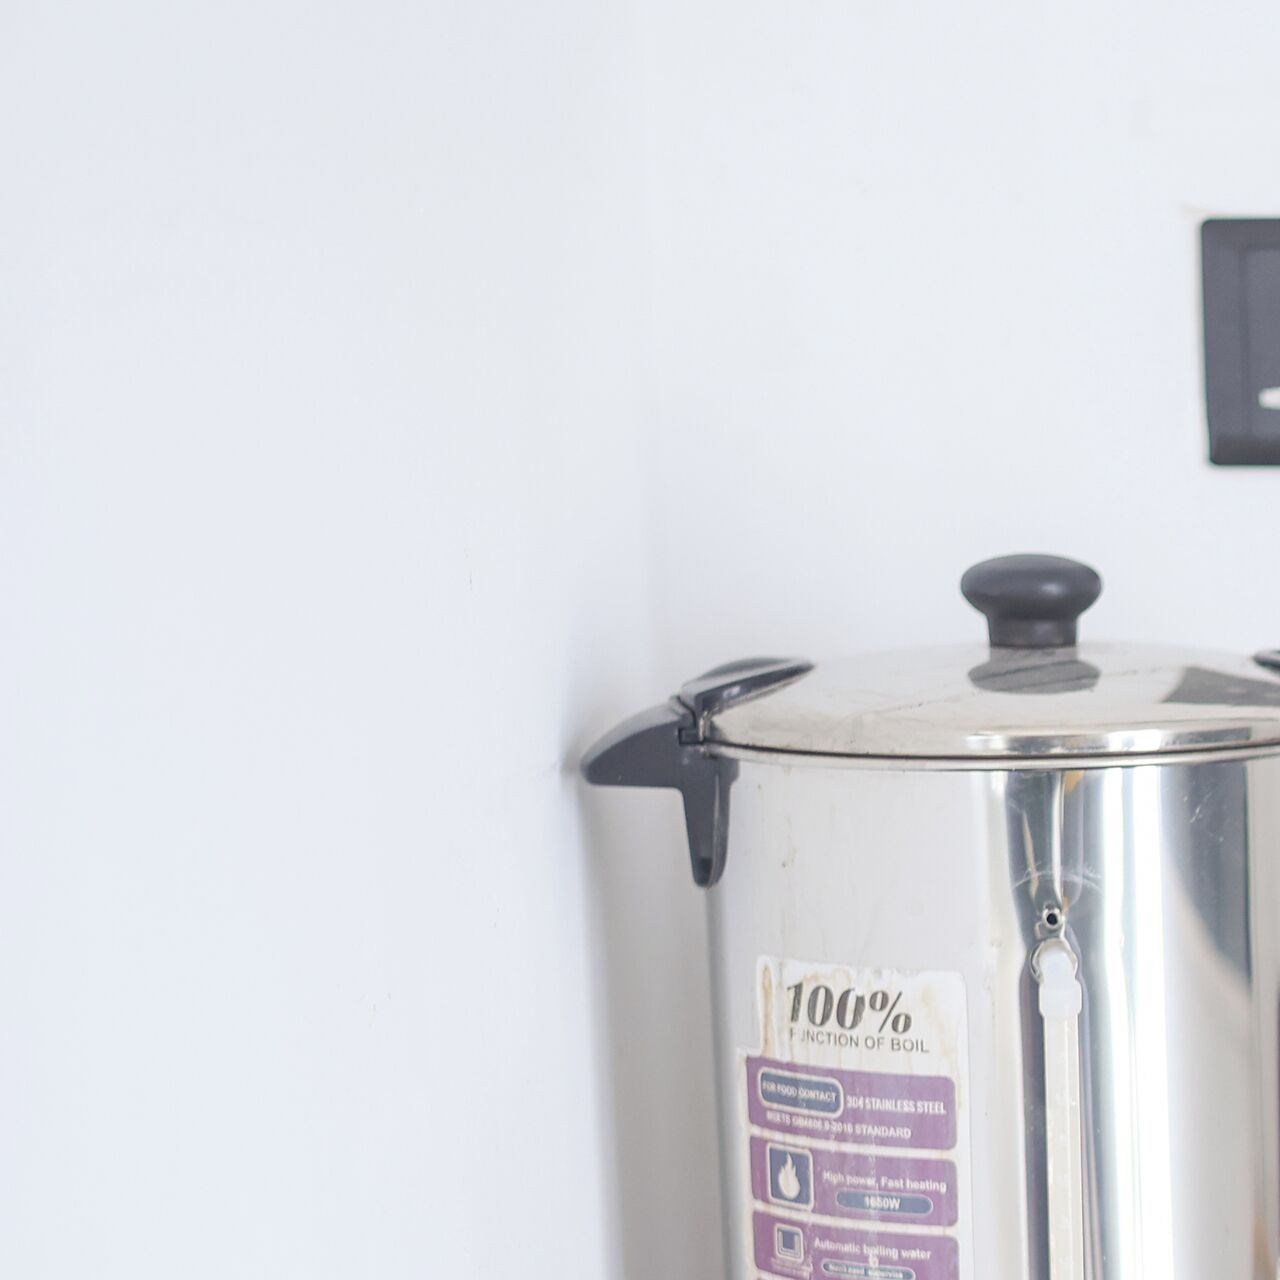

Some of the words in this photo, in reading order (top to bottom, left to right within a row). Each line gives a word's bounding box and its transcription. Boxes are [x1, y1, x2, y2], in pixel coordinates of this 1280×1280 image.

[787, 981, 912, 1035] 100%
[864, 1035, 885, 1050] OF
[890, 1037, 930, 1053] BOIL
[798, 1087, 837, 1102] CONTACT
[865, 1097, 915, 1113] STAINLESS
[917, 1100, 946, 1115] STEEL
[855, 1123, 912, 1138] STANDARD
[823, 1171, 844, 1185] High
[881, 1176, 904, 1188] Fast
[906, 1178, 947, 1194] heating
[814, 1238, 861, 1253] Automatic
[901, 1249, 932, 1259] water
